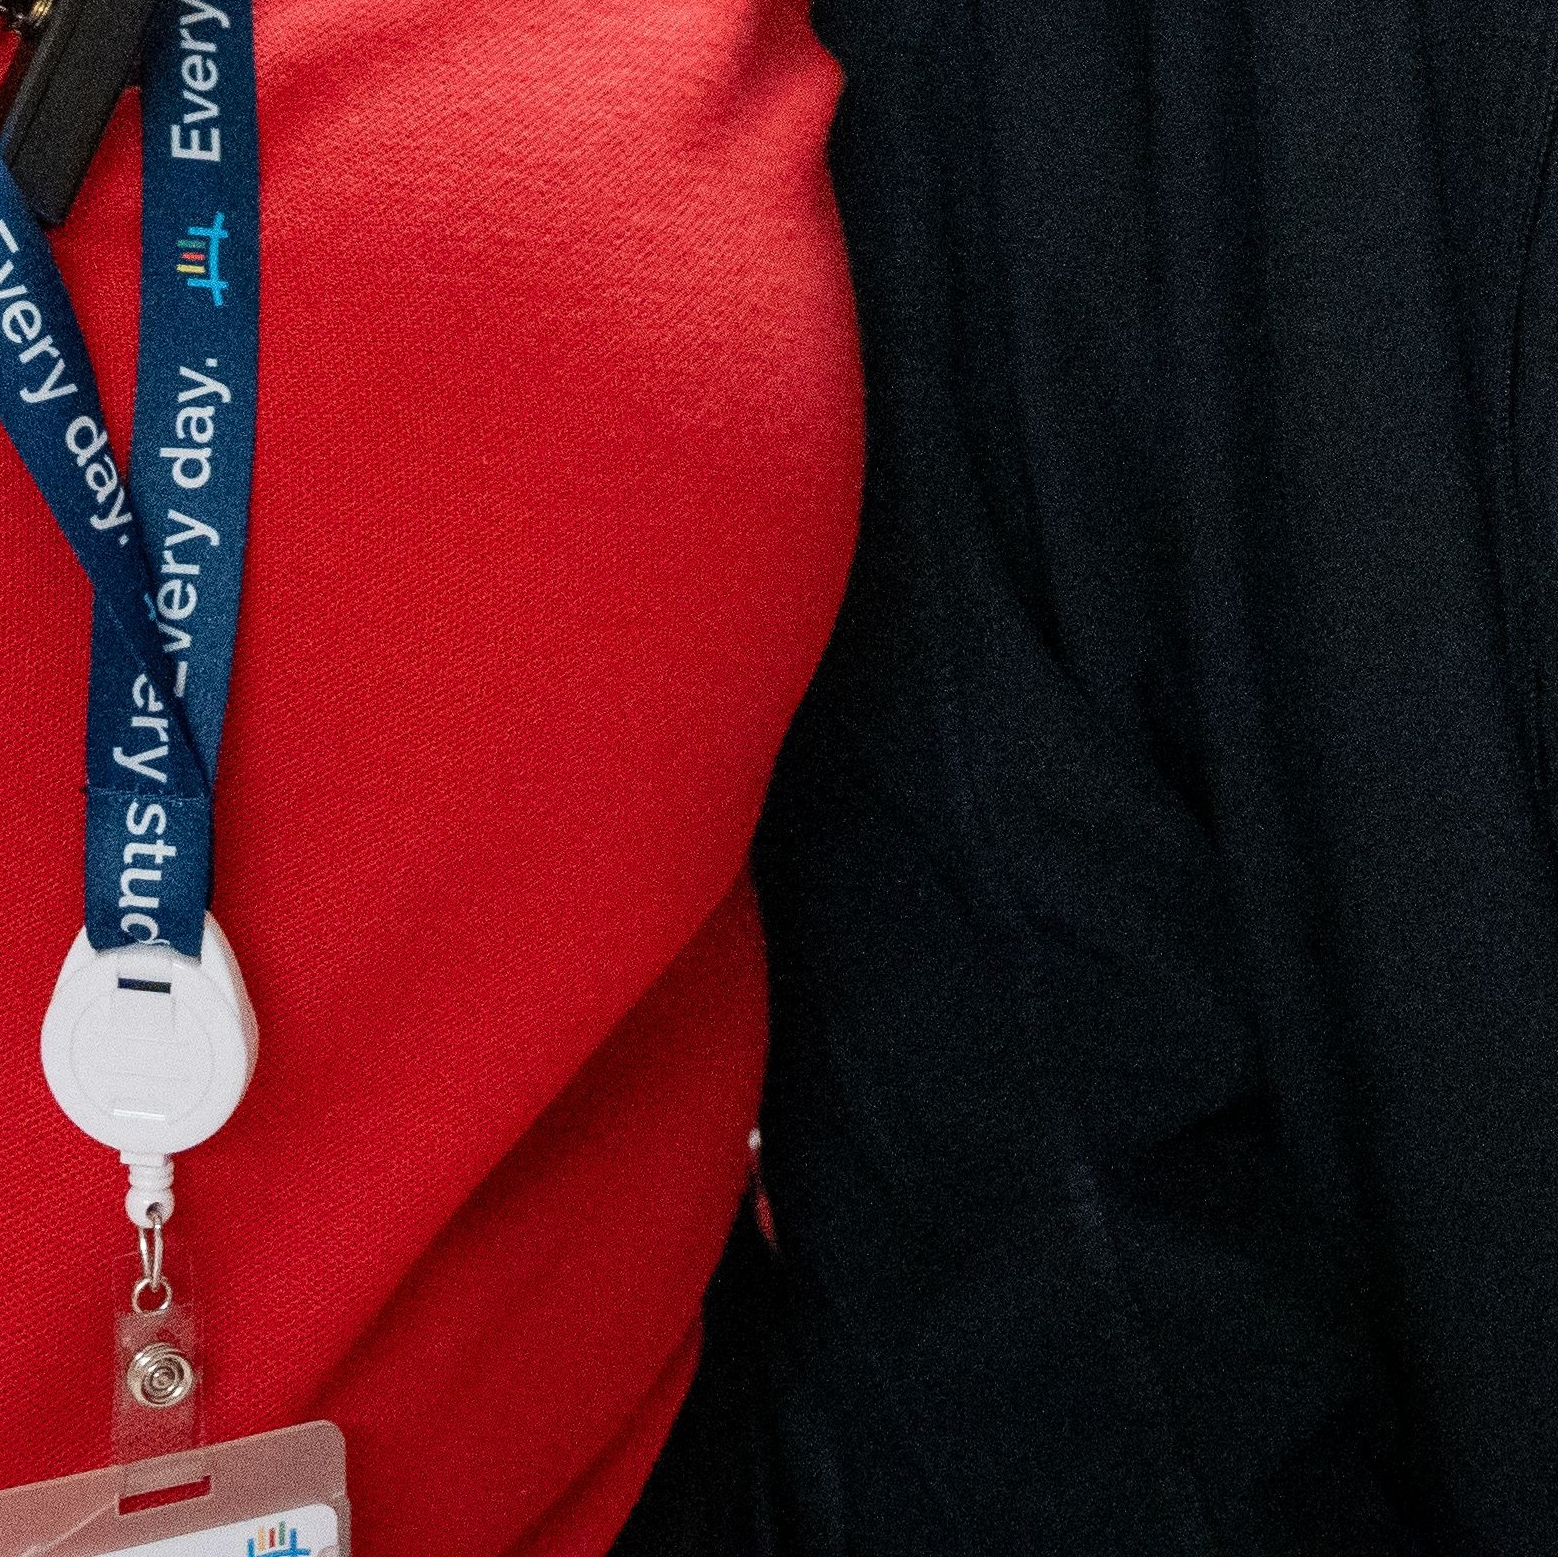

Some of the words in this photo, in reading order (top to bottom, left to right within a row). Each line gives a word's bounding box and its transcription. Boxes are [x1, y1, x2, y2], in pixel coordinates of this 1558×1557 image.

[64, 415, 134, 546] day.
[160, 357, 231, 489] day.
[113, 672, 170, 784] ery
